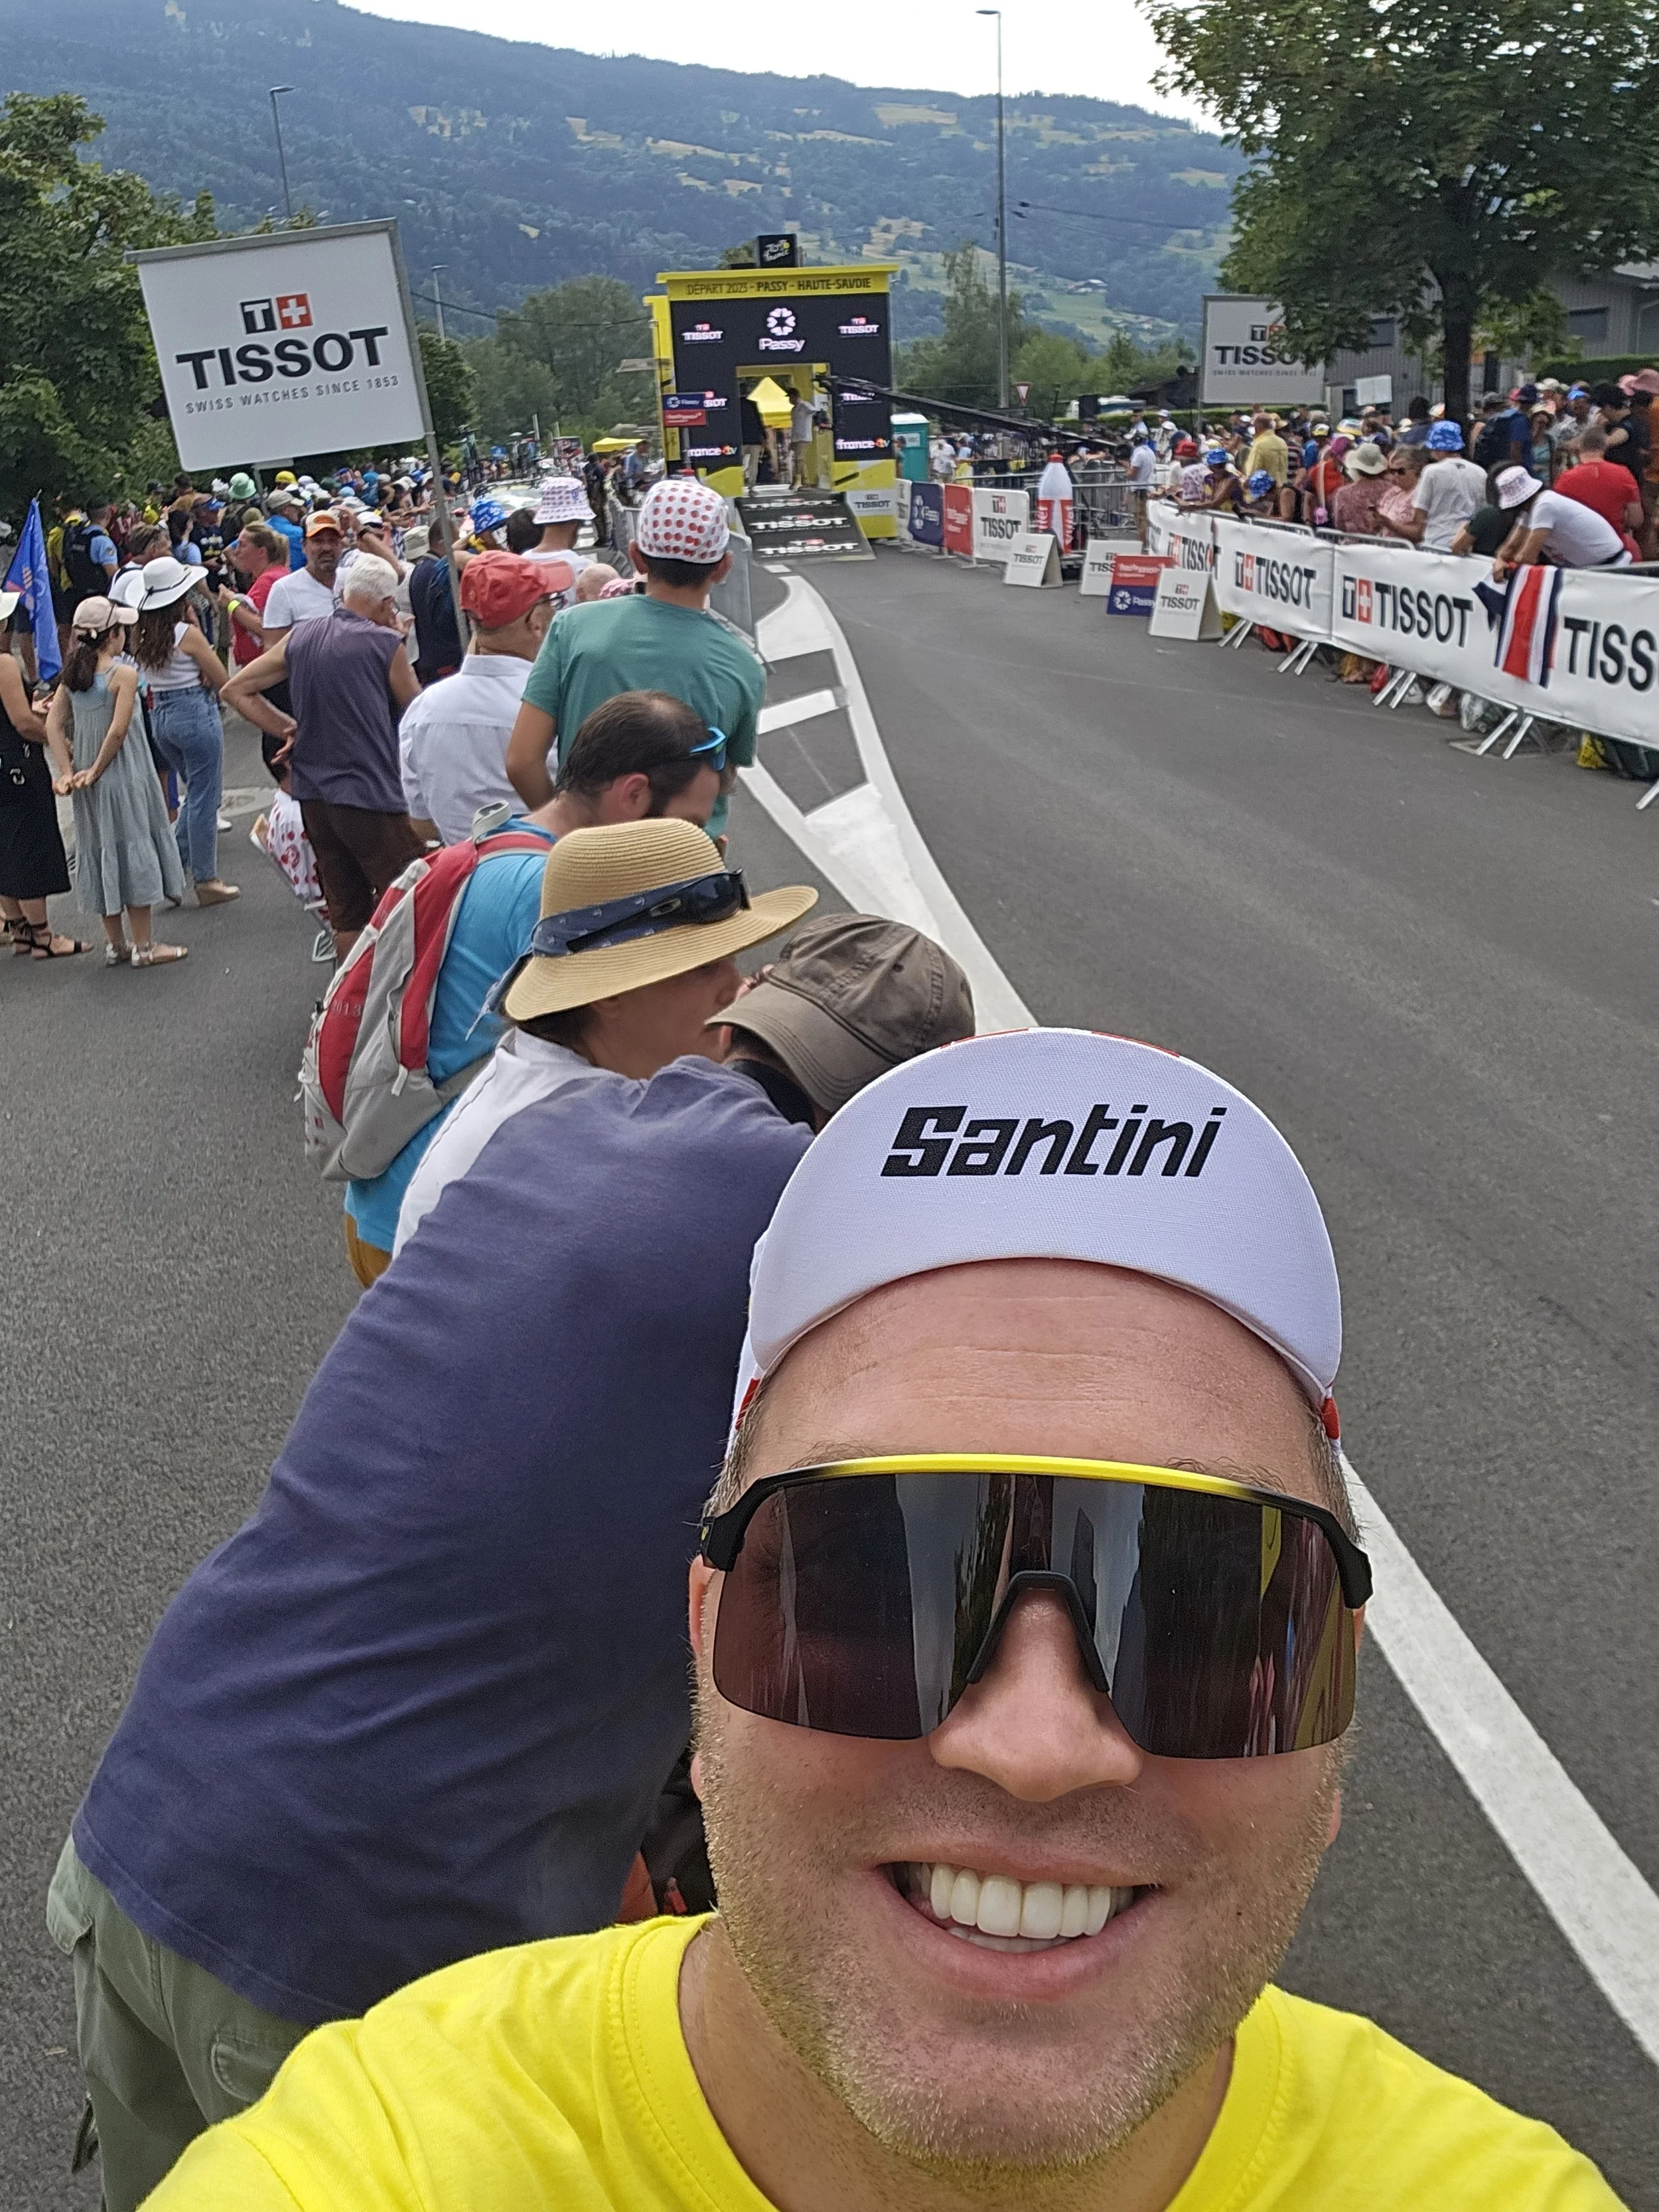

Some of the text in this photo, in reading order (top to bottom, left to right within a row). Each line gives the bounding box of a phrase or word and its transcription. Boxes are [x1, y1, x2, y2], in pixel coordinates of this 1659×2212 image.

[757, 281, 788, 292] PASSY
[798, 277, 871, 290] HAUTE-SAVOIE
[682, 331, 723, 340] TISSOT
[838, 325, 879, 334] TISSOT
[758, 338, 805, 352] Passy
[175, 327, 389, 390] TISSOT
[1213, 346, 1299, 365] TISSO
[185, 375, 399, 414] SWISS WATCHES SINCE 1853
[743, 500, 837, 508] TISSOT
[854, 500, 891, 508] TISSOT
[749, 517, 847, 530] TISSOT
[980, 516, 1021, 540] TISSOT
[757, 543, 859, 555] TISSOT
[1013, 553, 1045, 565] TISSOT
[1089, 561, 1116, 573] TISS
[1256, 556, 1317, 609] TISSOT
[1133, 596, 1155, 607] Passy
[1161, 595, 1200, 611] TISSOT
[1375, 581, 1473, 648] TISSOT
[1564, 615, 1658, 692] TISS
[880, 1104, 1228, 1177] Santini
